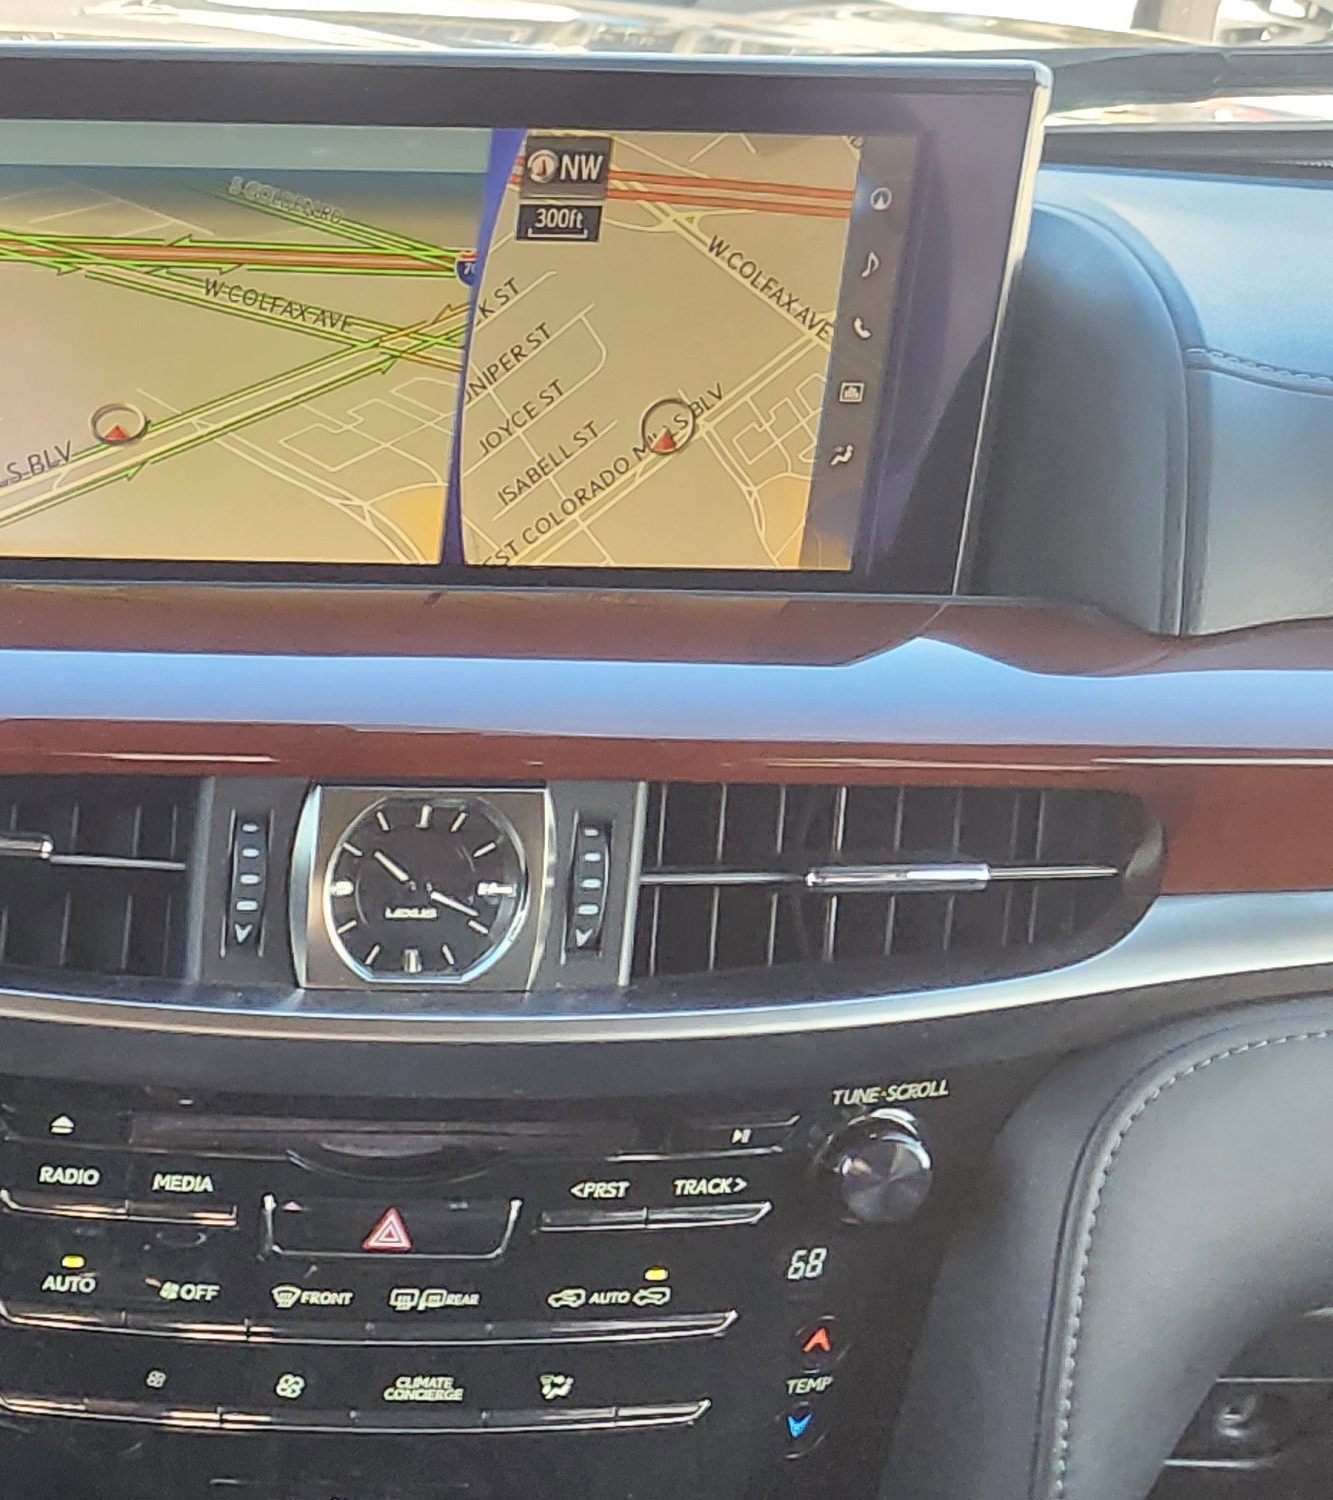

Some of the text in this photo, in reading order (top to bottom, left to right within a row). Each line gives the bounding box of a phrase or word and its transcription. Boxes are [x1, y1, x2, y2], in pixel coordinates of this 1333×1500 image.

[560, 154, 603, 180] NW
[535, 208, 583, 228] 300ft
[493, 277, 520, 306] ST
[707, 234, 834, 341] W COLFAX AVE
[204, 277, 354, 334] W COLFAX AVE
[525, 322, 551, 351] ST
[479, 378, 565, 456] JOYCE ST
[28, 440, 72, 475] BLV
[497, 420, 600, 505] ISABELL ST
[521, 456, 630, 545] COLORADO
[688, 382, 724, 419] BLV
[39, 1166, 100, 1186] RADIO
[152, 1174, 214, 1192] MEDIA
[788, 1248, 827, 1280] 68
[42, 1275, 96, 1293] AUTO
[180, 1284, 220, 1300] OFF
[300, 1291, 354, 1305] FRONT
[447, 1293, 480, 1305] REAR
[588, 1291, 631, 1304] AUTO
[396, 1376, 454, 1388] CLIMATE
[786, 1376, 833, 1394] TEMP
[384, 1388, 463, 1401] CONCIERGE
